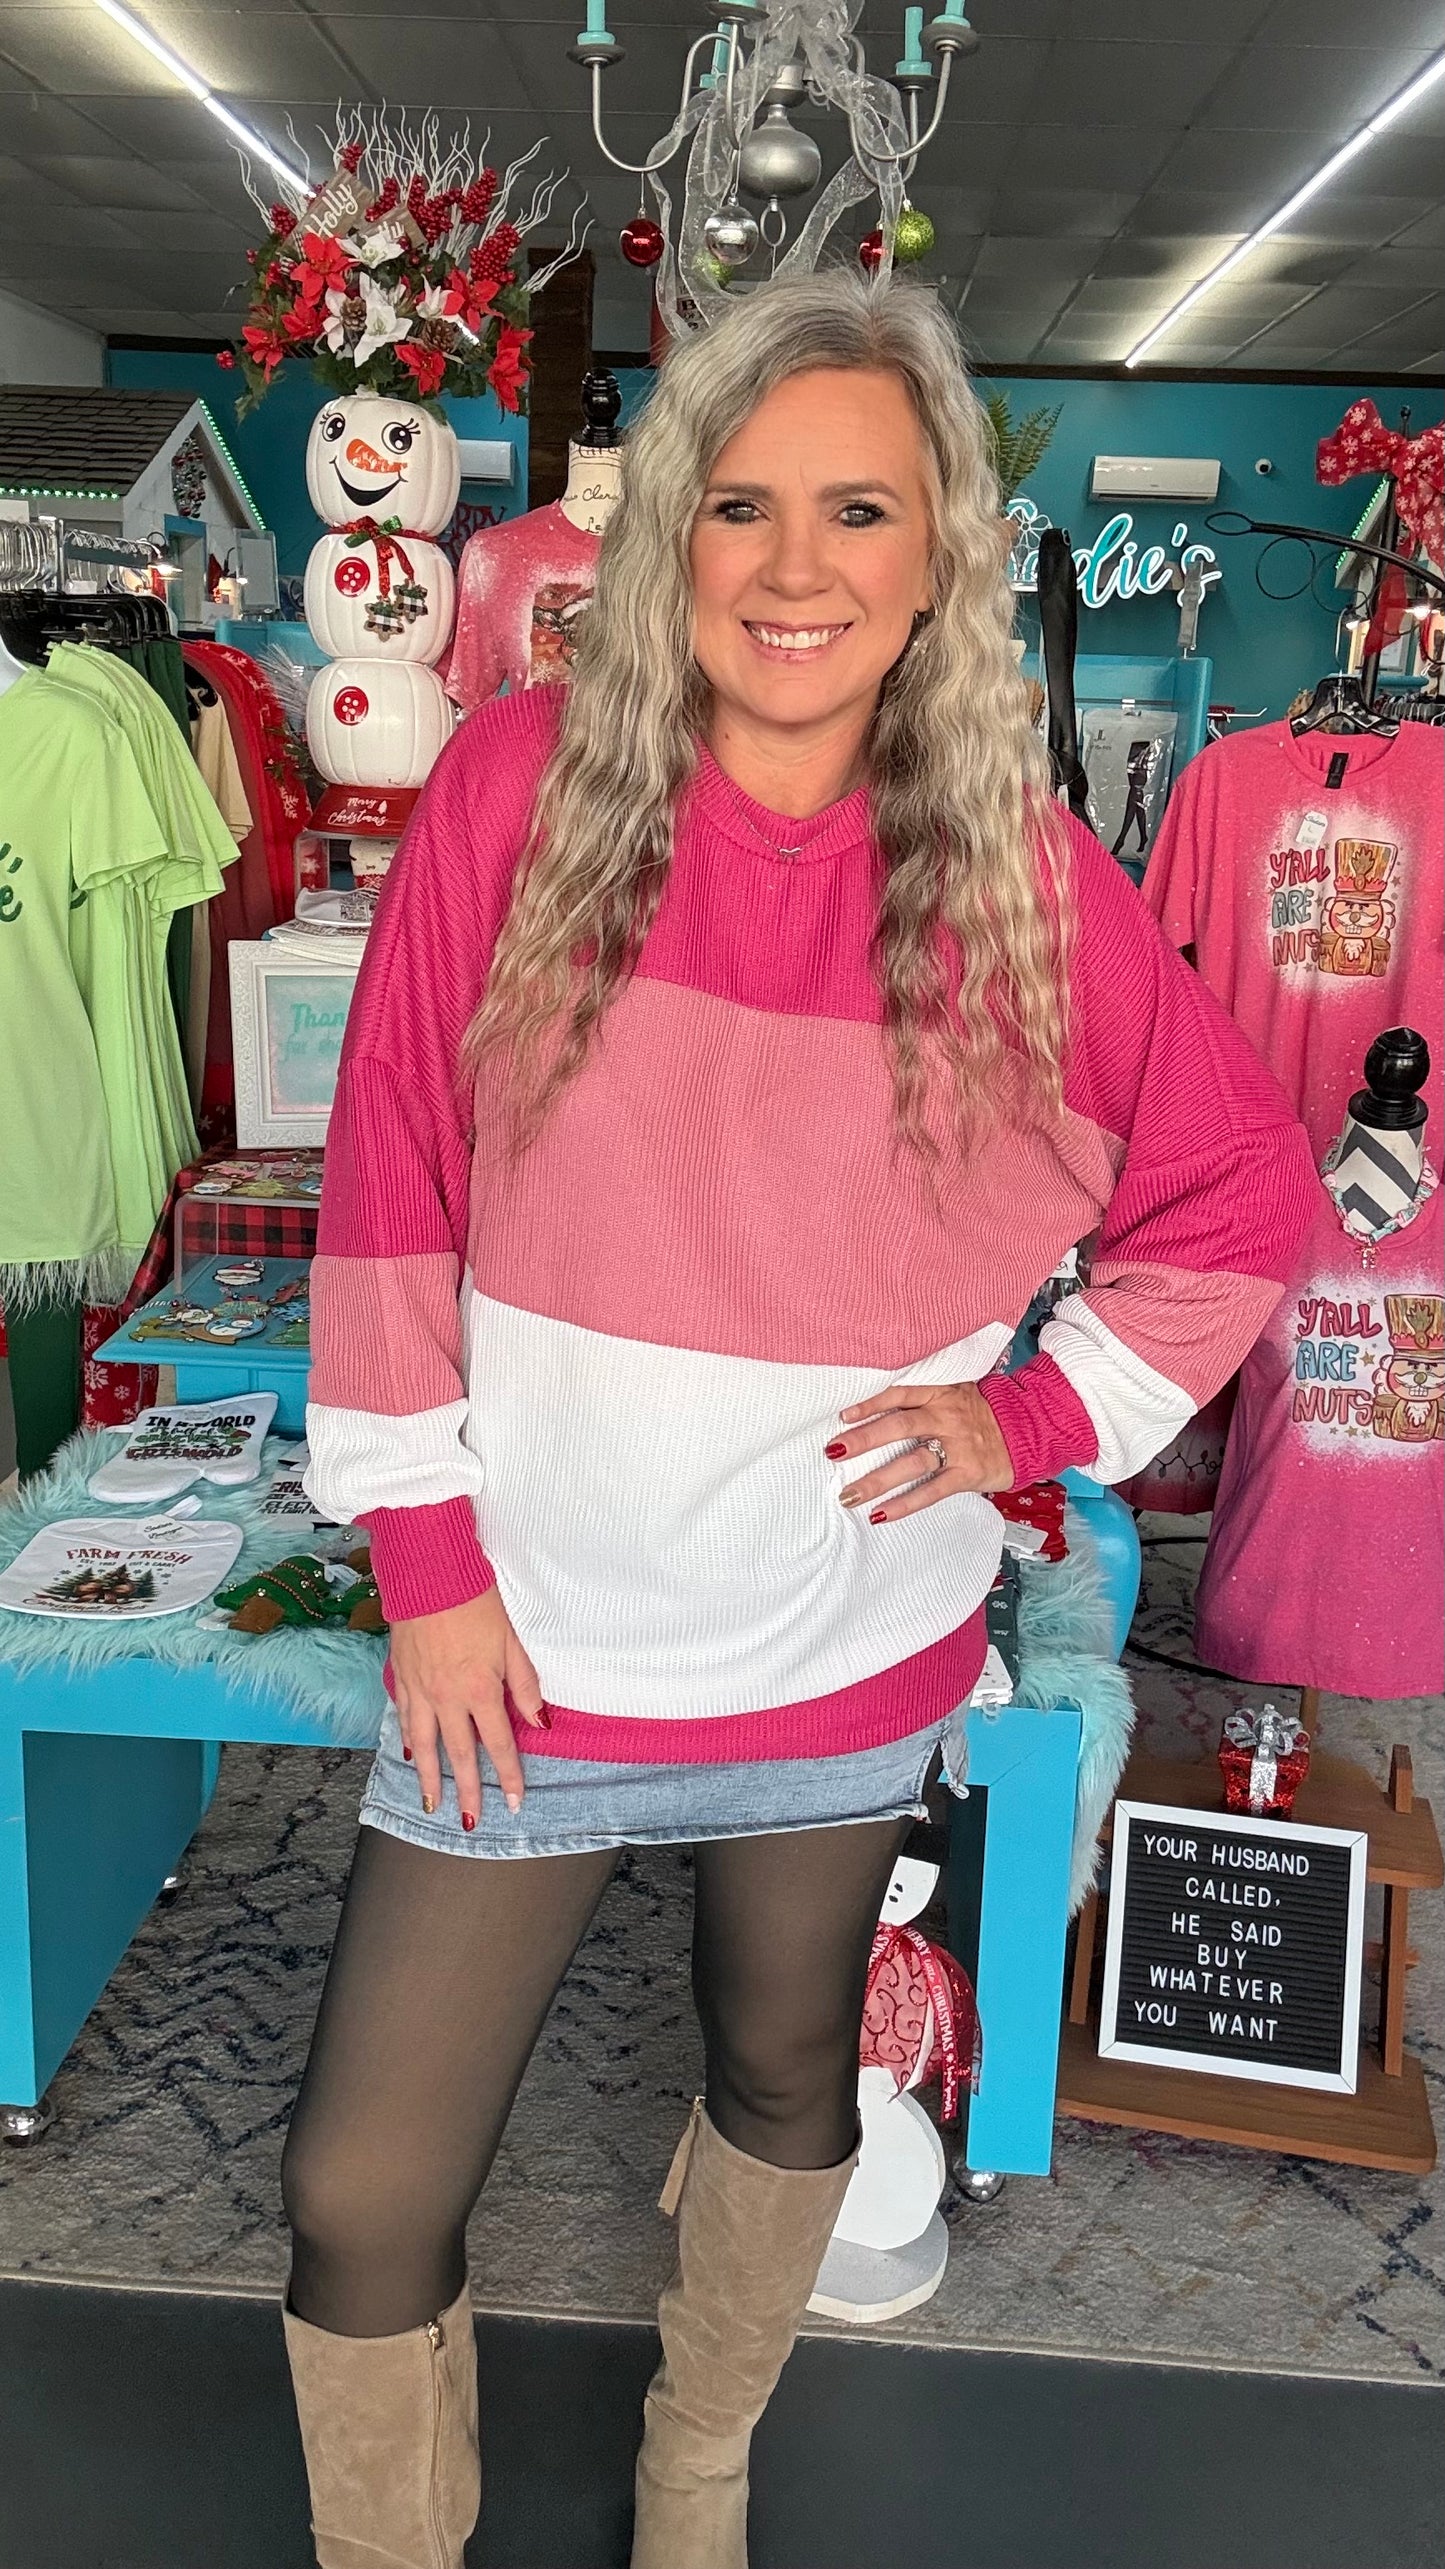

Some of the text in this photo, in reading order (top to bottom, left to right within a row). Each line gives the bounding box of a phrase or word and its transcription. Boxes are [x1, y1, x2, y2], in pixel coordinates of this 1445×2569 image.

[304, 183, 358, 238] Holly
[327, 809, 388, 827] Christmas
[347, 797, 377, 809] Merry
[1270, 848, 1330, 889] Y'ALL
[1272, 889, 1314, 928] ARE
[1273, 929, 1322, 966] NUTS
[1297, 1297, 1383, 1338] Y'ALL
[1296, 1340, 1359, 1381] ARE
[146, 1416, 172, 1427] IN
[1293, 1386, 1373, 1426] NUTS
[66, 1548, 194, 1565] FARM FRESH
[1143, 1834, 1310, 1876] YOUR HUSBAND
[1185, 1877, 1281, 1908] CALLED,
[1171, 1911, 1282, 1947] HE SAID
[1197, 1944, 1247, 1970] BUY
[1150, 1965, 1283, 2005] WHATEVER
[931, 1985, 954, 2052] CHRISTMAS
[1135, 2000, 1278, 2042] YOU WANT
